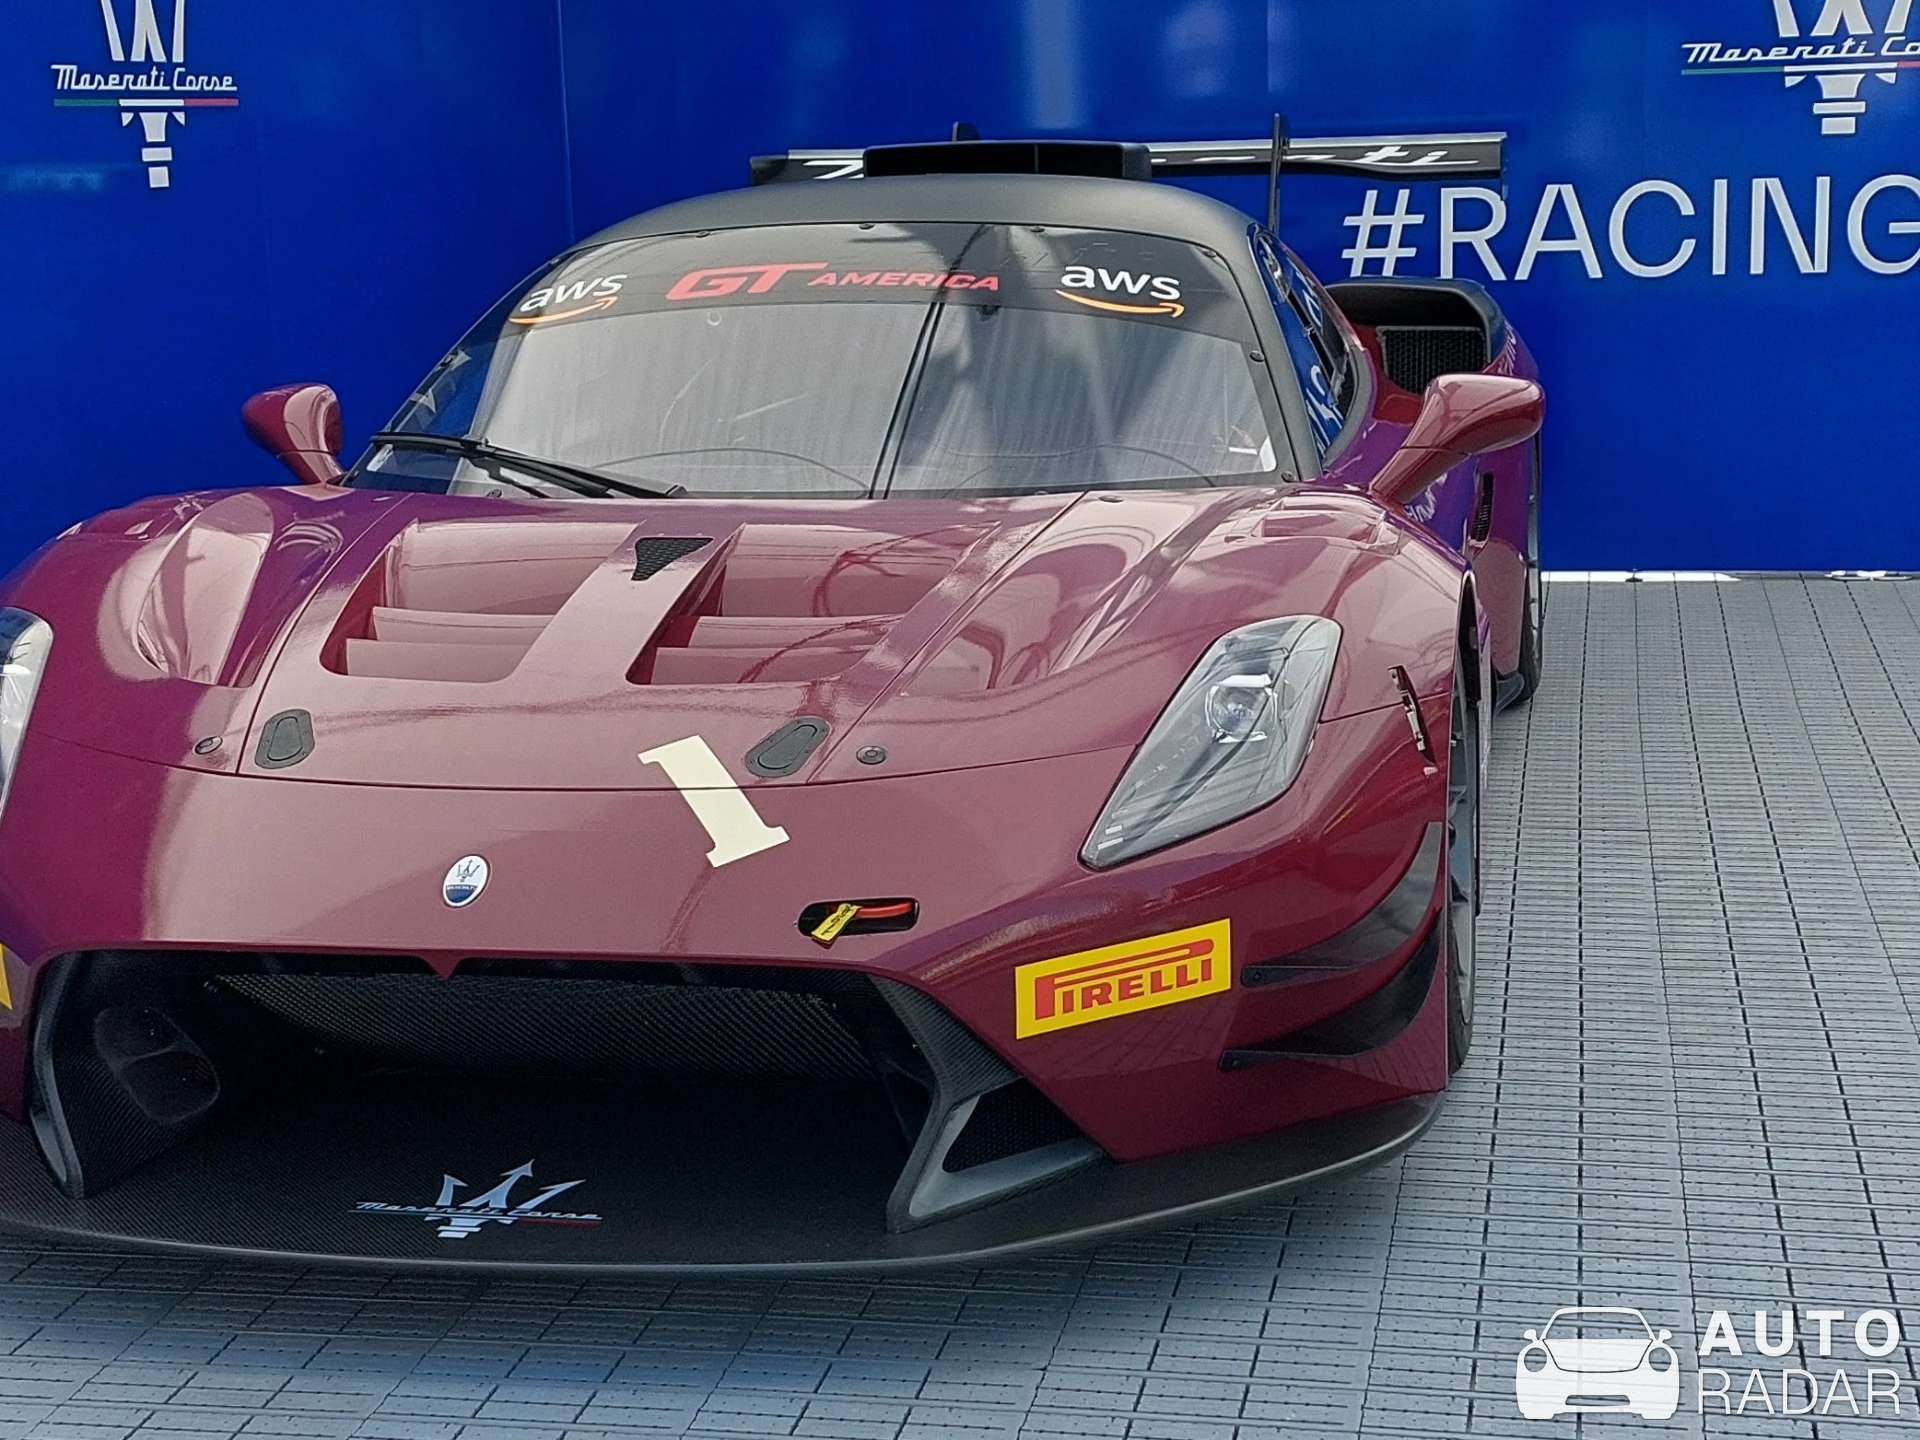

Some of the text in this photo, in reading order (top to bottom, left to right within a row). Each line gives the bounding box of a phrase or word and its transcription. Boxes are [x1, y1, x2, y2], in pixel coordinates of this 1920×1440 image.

[1681, 37, 1875, 63] Maserati
[51, 64, 238, 90] Maserati Corse
[1341, 174, 1920, 281] #RACING
[520, 274, 628, 313] aws
[665, 262, 999, 300] GT AMERICA
[1060, 264, 1181, 300] aws
[637, 734, 790, 867] 1
[1034, 938, 1215, 1021] PIRELLI
[356, 1202, 603, 1220] Maserati Corse
